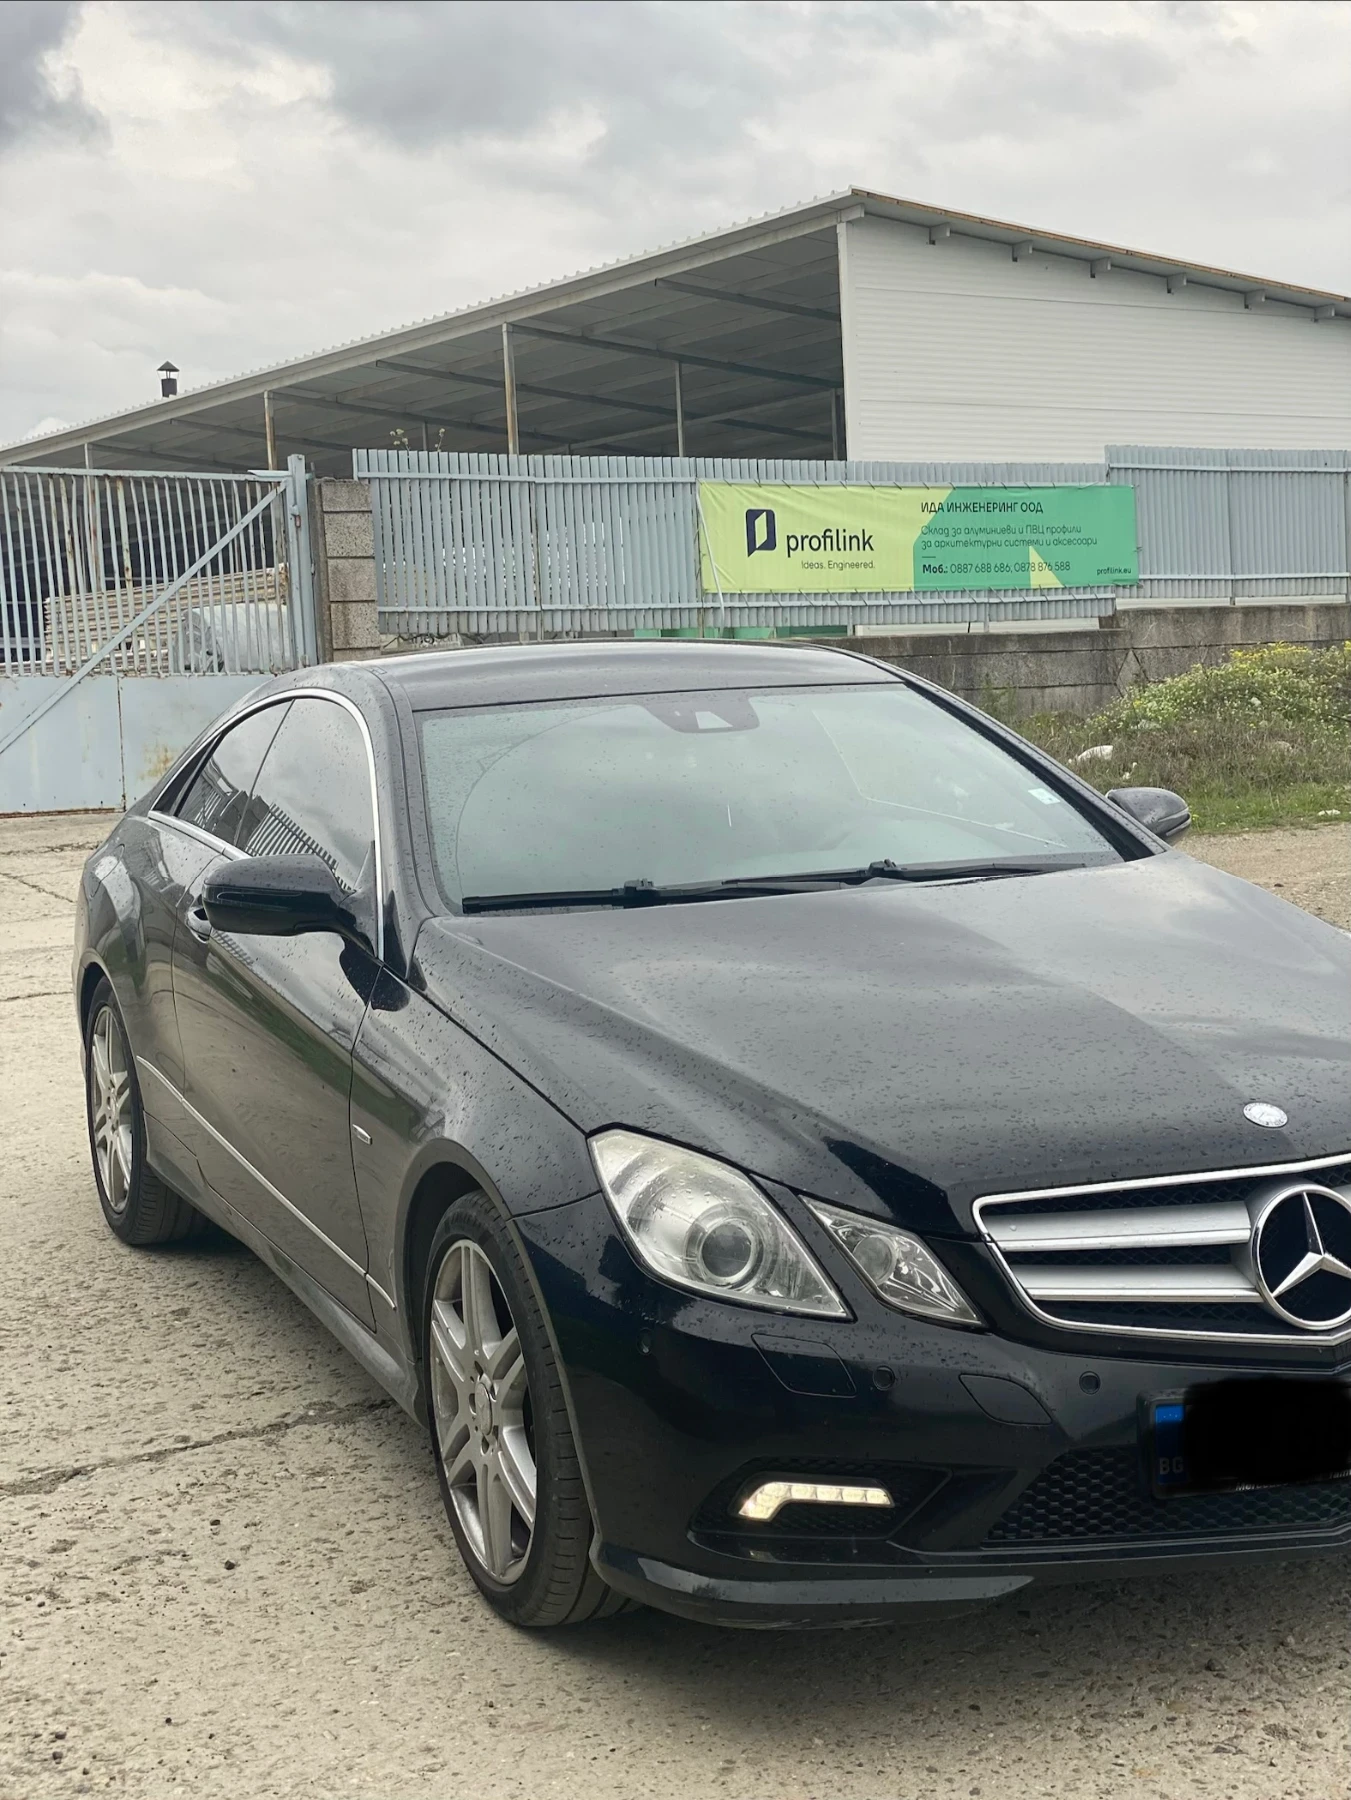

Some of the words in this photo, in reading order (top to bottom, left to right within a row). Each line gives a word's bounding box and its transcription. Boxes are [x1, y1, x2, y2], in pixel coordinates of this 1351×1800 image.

[921, 502, 945, 514] ИДА
[947, 502, 1018, 513] ИНЖЕНЕРИНГ
[1020, 501, 1043, 514] ООД
[921, 525, 949, 537] Склад
[951, 528, 962, 537] за
[964, 525, 1017, 536] алуминиеви
[1026, 524, 1045, 535] ПВЦ
[1046, 525, 1082, 535] профили
[786, 528, 874, 558] profilink
[921, 540, 932, 550] за
[934, 538, 1002, 549] архитектурни
[1004, 539, 1044, 547] системи
[1052, 537, 1097, 547] аксесоари
[801, 560, 826, 570] Ideas.
[828, 560, 875, 571] Engineered.
[950, 563, 973, 574] 0887
[974, 563, 992, 573] 688
[1014, 562, 1036, 573] 0878
[1037, 562, 1053, 572] 876
[1054, 561, 1070, 571] 588
[1096, 567, 1131, 576] profilink.eu
[1159, 1456, 1184, 1475] BG
